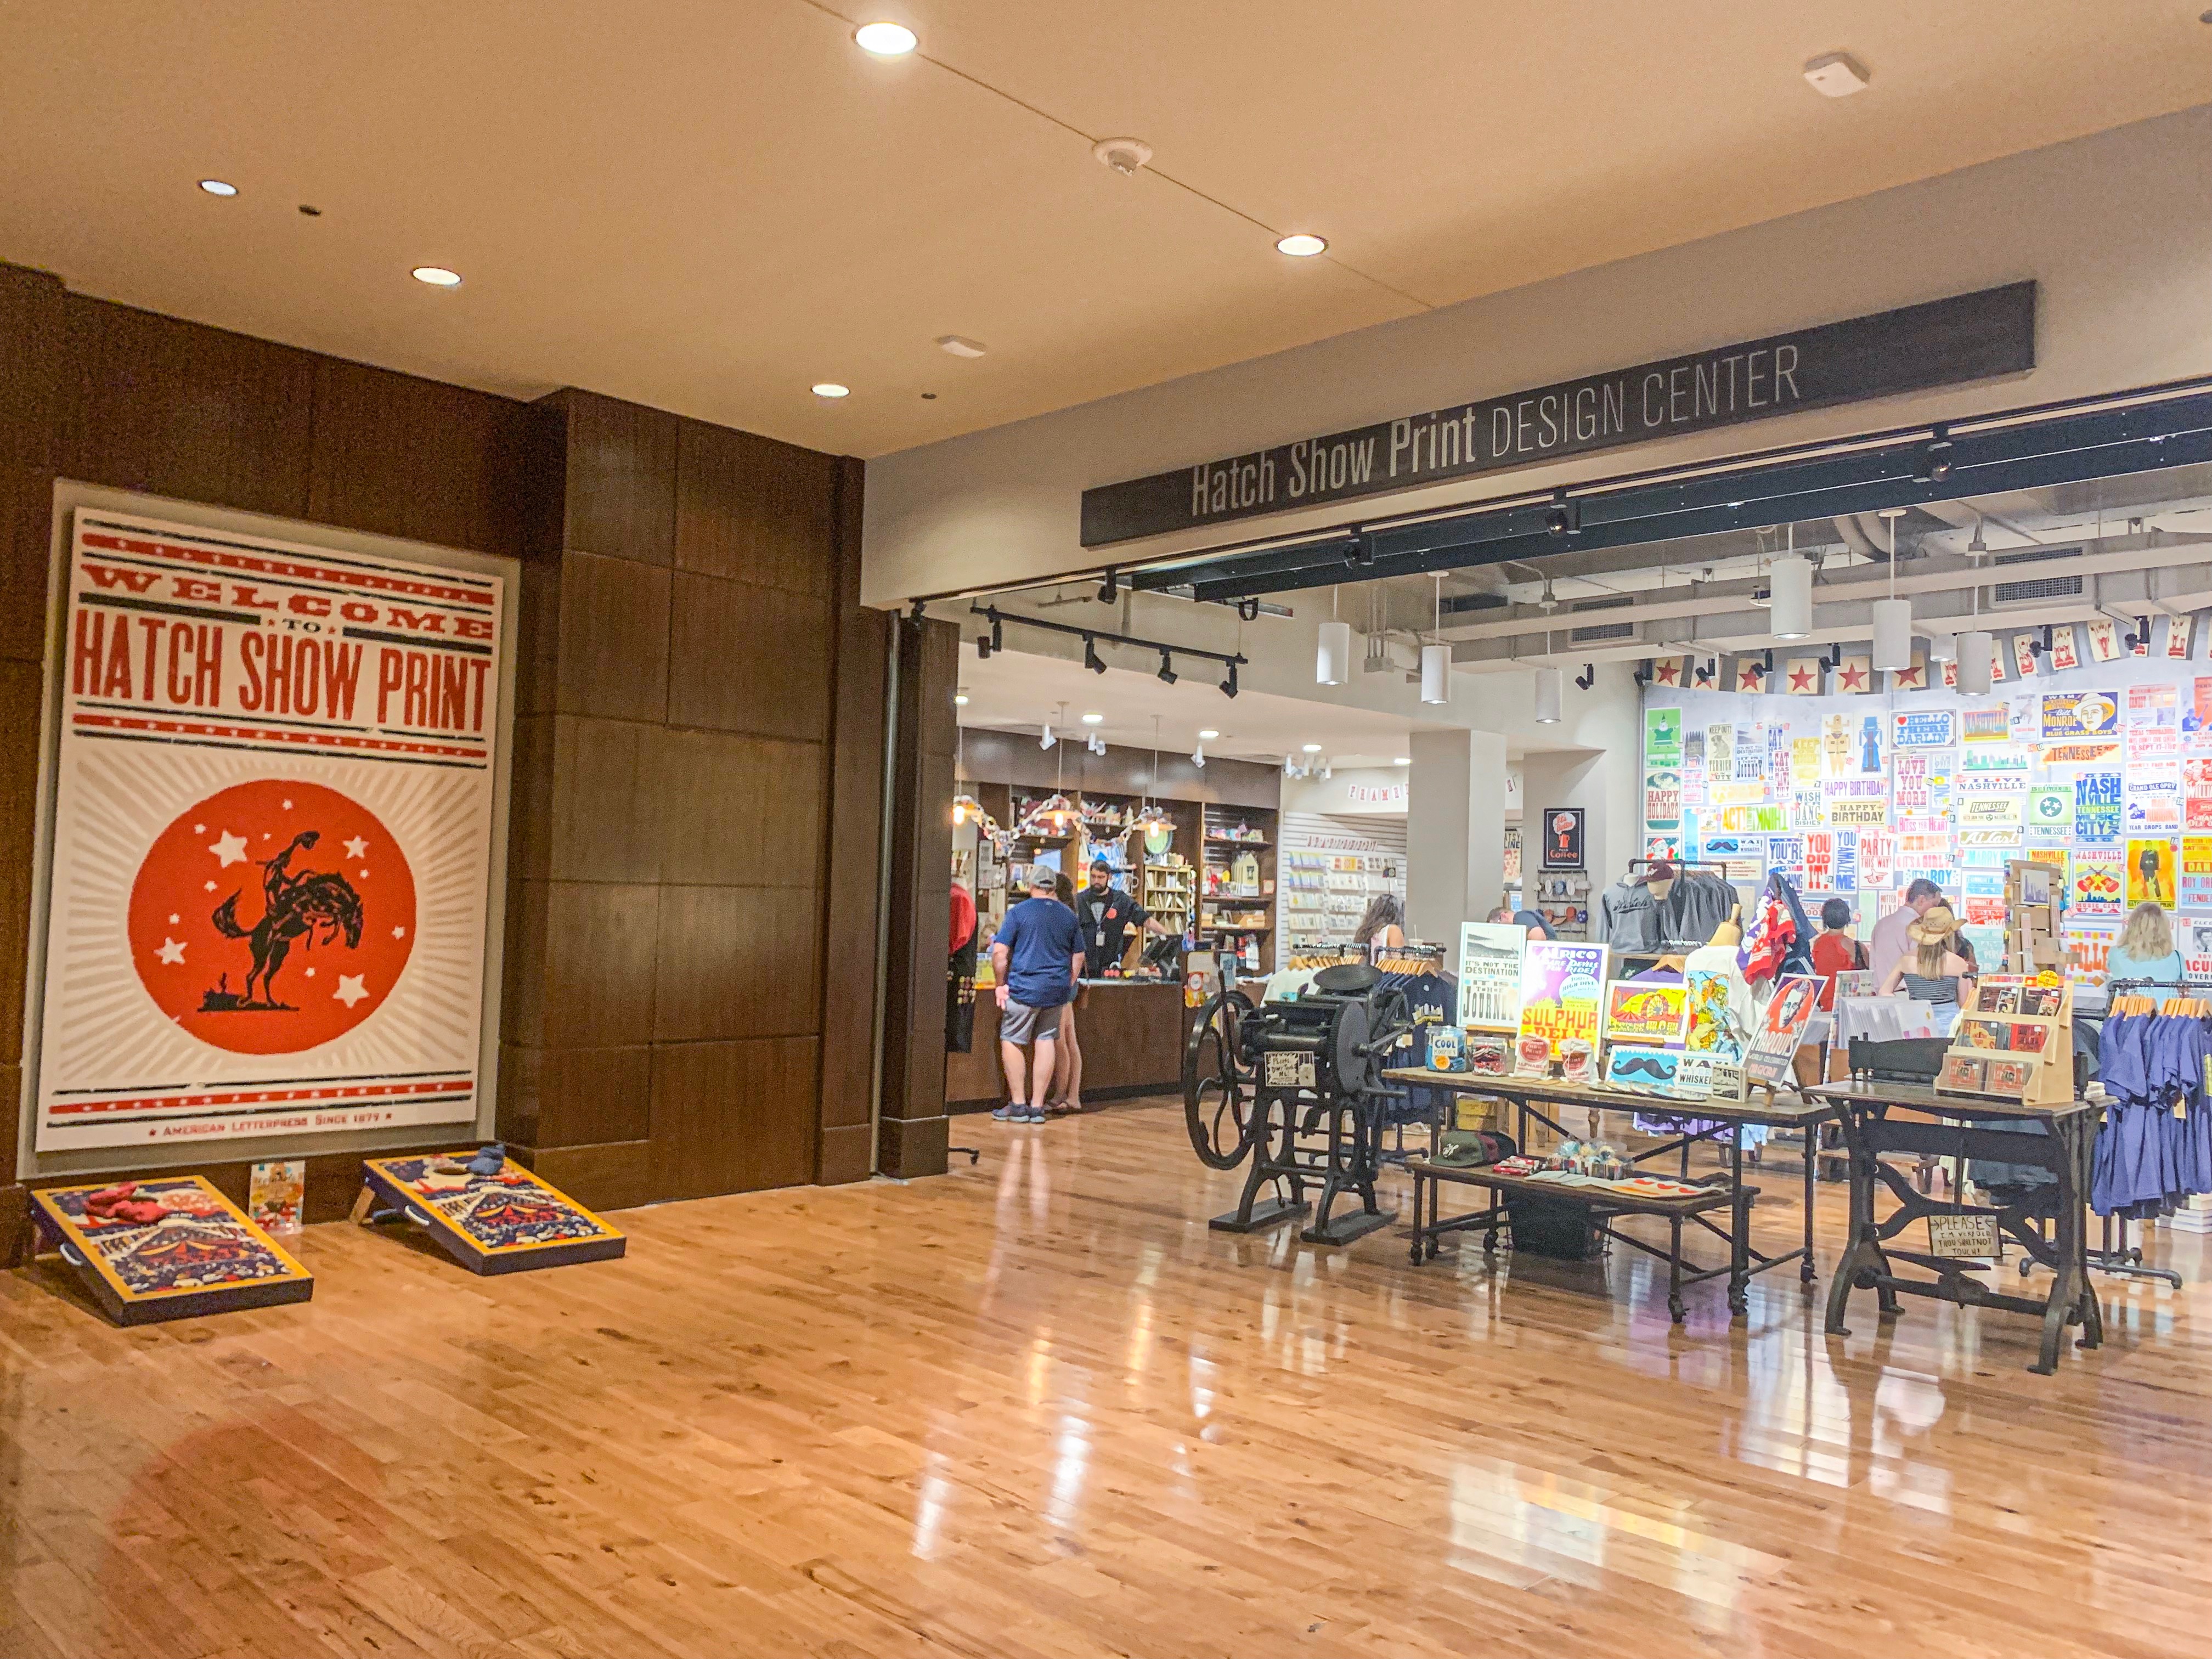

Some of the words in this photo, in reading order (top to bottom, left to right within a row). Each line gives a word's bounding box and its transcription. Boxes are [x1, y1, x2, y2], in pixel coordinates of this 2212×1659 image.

[1192, 452, 1275, 516] Hatch
[1289, 436, 1375, 498] Show
[1390, 406, 1476, 477] Print
[1492, 381, 1624, 457] DESIGN
[1643, 345, 1800, 427] CENTER
[81, 564, 493, 640] WELCOME
[282, 618, 321, 634] TO
[72, 610, 223, 707] HATCH
[238, 631, 364, 720] SHOW
[377, 648, 490, 733] PRINT
[1907, 714, 1950, 725] HELLO
[1965, 712, 2008, 733] NASHVILLE
[2043, 714, 2078, 727] MONROE
[1897, 725, 1949, 734] THERE
[1768, 729, 1783, 747] CAT
[1775, 752, 1789, 766] CAT
[2052, 746, 2102, 761] TENNESSEE
[1898, 759, 1926, 775] LOVE
[1825, 781, 1848, 797] HAPPY
[1849, 780, 1887, 796] BIRTHDAY!
[1900, 775, 1923, 790] YOU
[1647, 791, 1679, 802] HAPPY
[1795, 792, 1820, 802] WASH
[1897, 791, 1927, 805] MORE
[1647, 802, 1678, 819] HOLIDAYS
[1796, 806, 1820, 821] DANG
[1971, 802, 2007, 812] TENNESSEE
[1722, 806, 1746, 831] ACT!
[1831, 811, 1884, 822] BIRTHDAY
[1929, 816, 1948, 831] HEART
[2034, 827, 2068, 836] TENNESSEE
[2075, 821, 2107, 835] CITY
[1807, 833, 1831, 853] YOU
[1837, 831, 1856, 846] YOU
[1550, 849, 1578, 858] Coffee
[1770, 842, 1803, 860] YOU'RE
[1861, 838, 1891, 855] PARTY
[1806, 854, 1831, 864] DID
[1837, 847, 1855, 874] AMAZE
[1903, 856, 1914, 867] IT'S
[1916, 856, 1921, 867] A
[1922, 855, 1944, 868] GIRL
[2032, 851, 2064, 859] NASHVILLE
[2075, 851, 2121, 860] NASHVILLE
[1861, 858, 1874, 868] THIS
[1877, 857, 1892, 869] WAY!
[1808, 865, 1829, 889] IT!
[1836, 874, 1855, 889] ME
[1930, 870, 1952, 885] BOY
[2182, 877, 2196, 888] ROY
[1565, 966, 1595, 975] RIDES
[1568, 959, 1599, 969] DEVILS
[2186, 960, 2212, 972] ACU
[1465, 967, 1519, 977] DESTINATION
[1562, 981, 1578, 991] HIGH
[1522, 1007, 1598, 1031] SULPHUR
[1534, 1026, 1585, 1039] DELL
[1435, 1039, 1456, 1048] COOL
[1748, 1053, 1763, 1061] WORLD
[1747, 1063, 1778, 1078] MAGICIAN
[163, 1124, 225, 1136] AMERICAN
[232, 1116, 308, 1132] LETTERPRESS
[315, 1114, 347, 1125] SINCE
[1939, 1216, 1984, 1231] PLEASE
[1939, 1239, 1956, 1248] THOU
